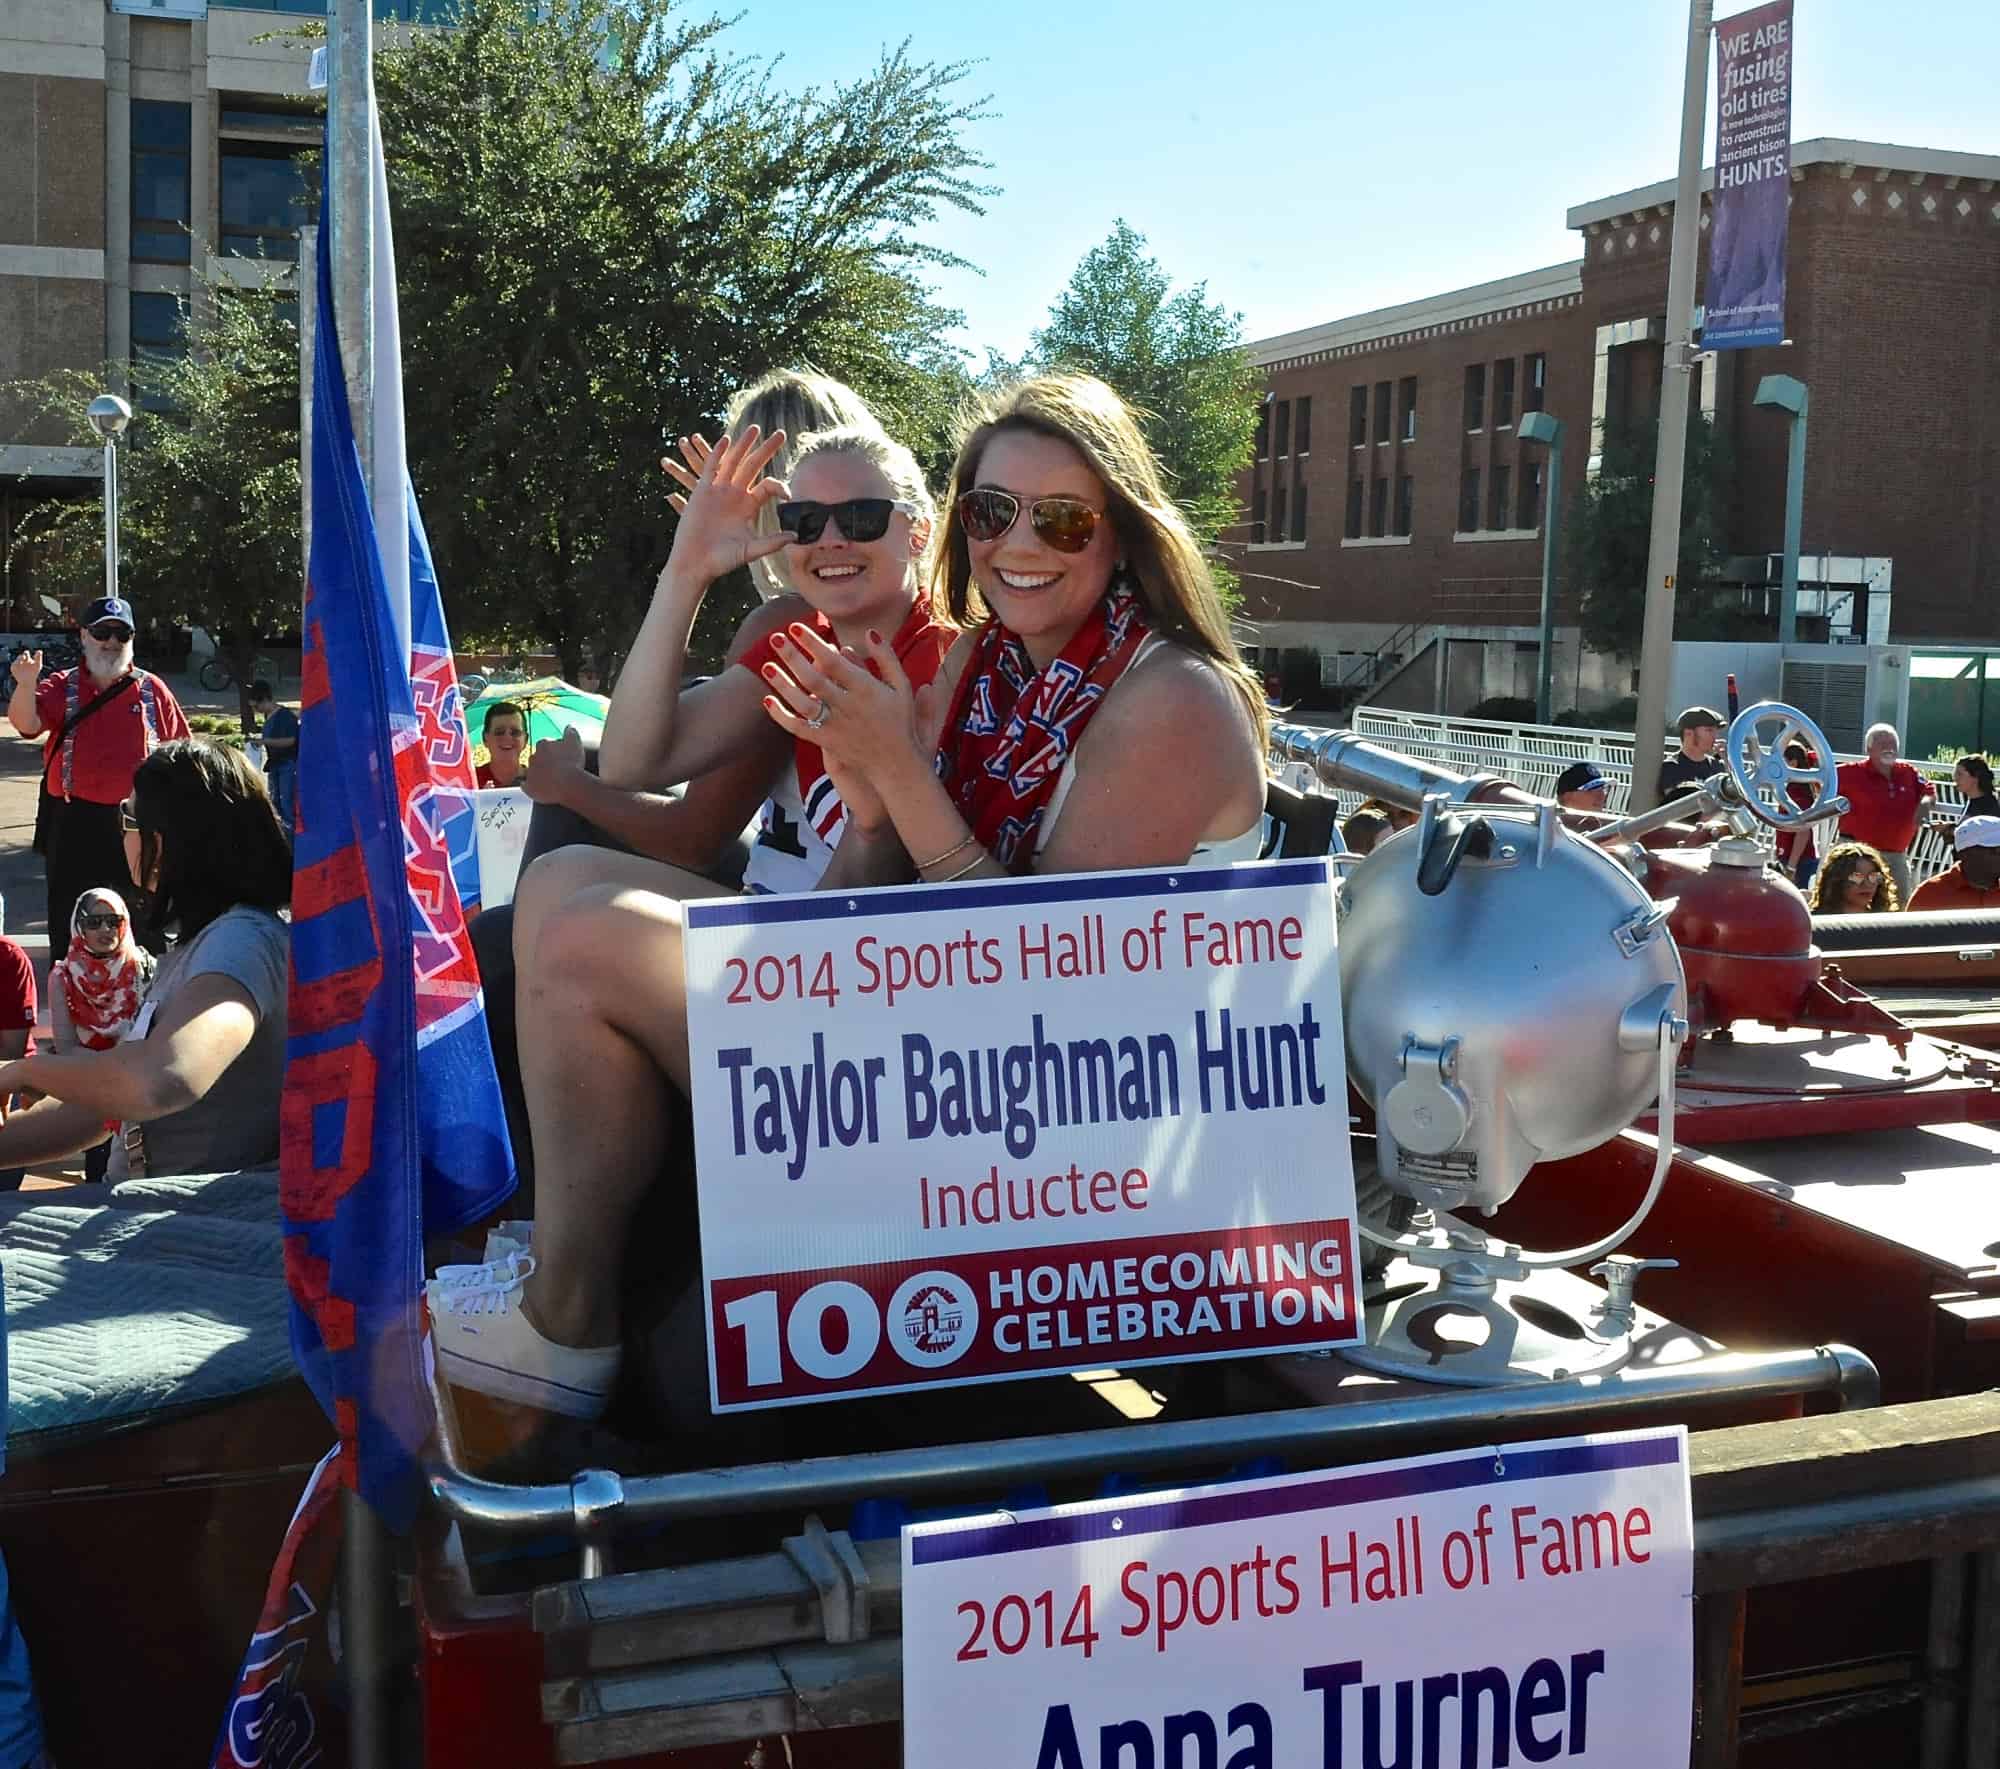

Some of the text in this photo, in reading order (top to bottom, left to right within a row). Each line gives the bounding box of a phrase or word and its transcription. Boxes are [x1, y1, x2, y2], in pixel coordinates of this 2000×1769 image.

[1721, 19, 1788, 60] WE ARE
[1721, 50, 1788, 98] fusing
[1721, 84, 1787, 117] old tires
[1720, 138, 1786, 163] ancient bison
[1721, 120, 1786, 146] to reconstruct
[1719, 154, 1787, 189] HUNTS.
[726, 910, 1304, 1008] 2014 Sports Hall of Fame
[717, 1002, 1326, 1181] Taylor Baughman Hunt
[920, 1164, 1150, 1229] Inductee
[989, 1239, 1342, 1309] HOMECOMING
[993, 1283, 1346, 1353] CELEBRATION
[956, 1504, 1653, 1662] 2014 Sports Hall of Fame
[1303, 1649, 1605, 1769] Turner
